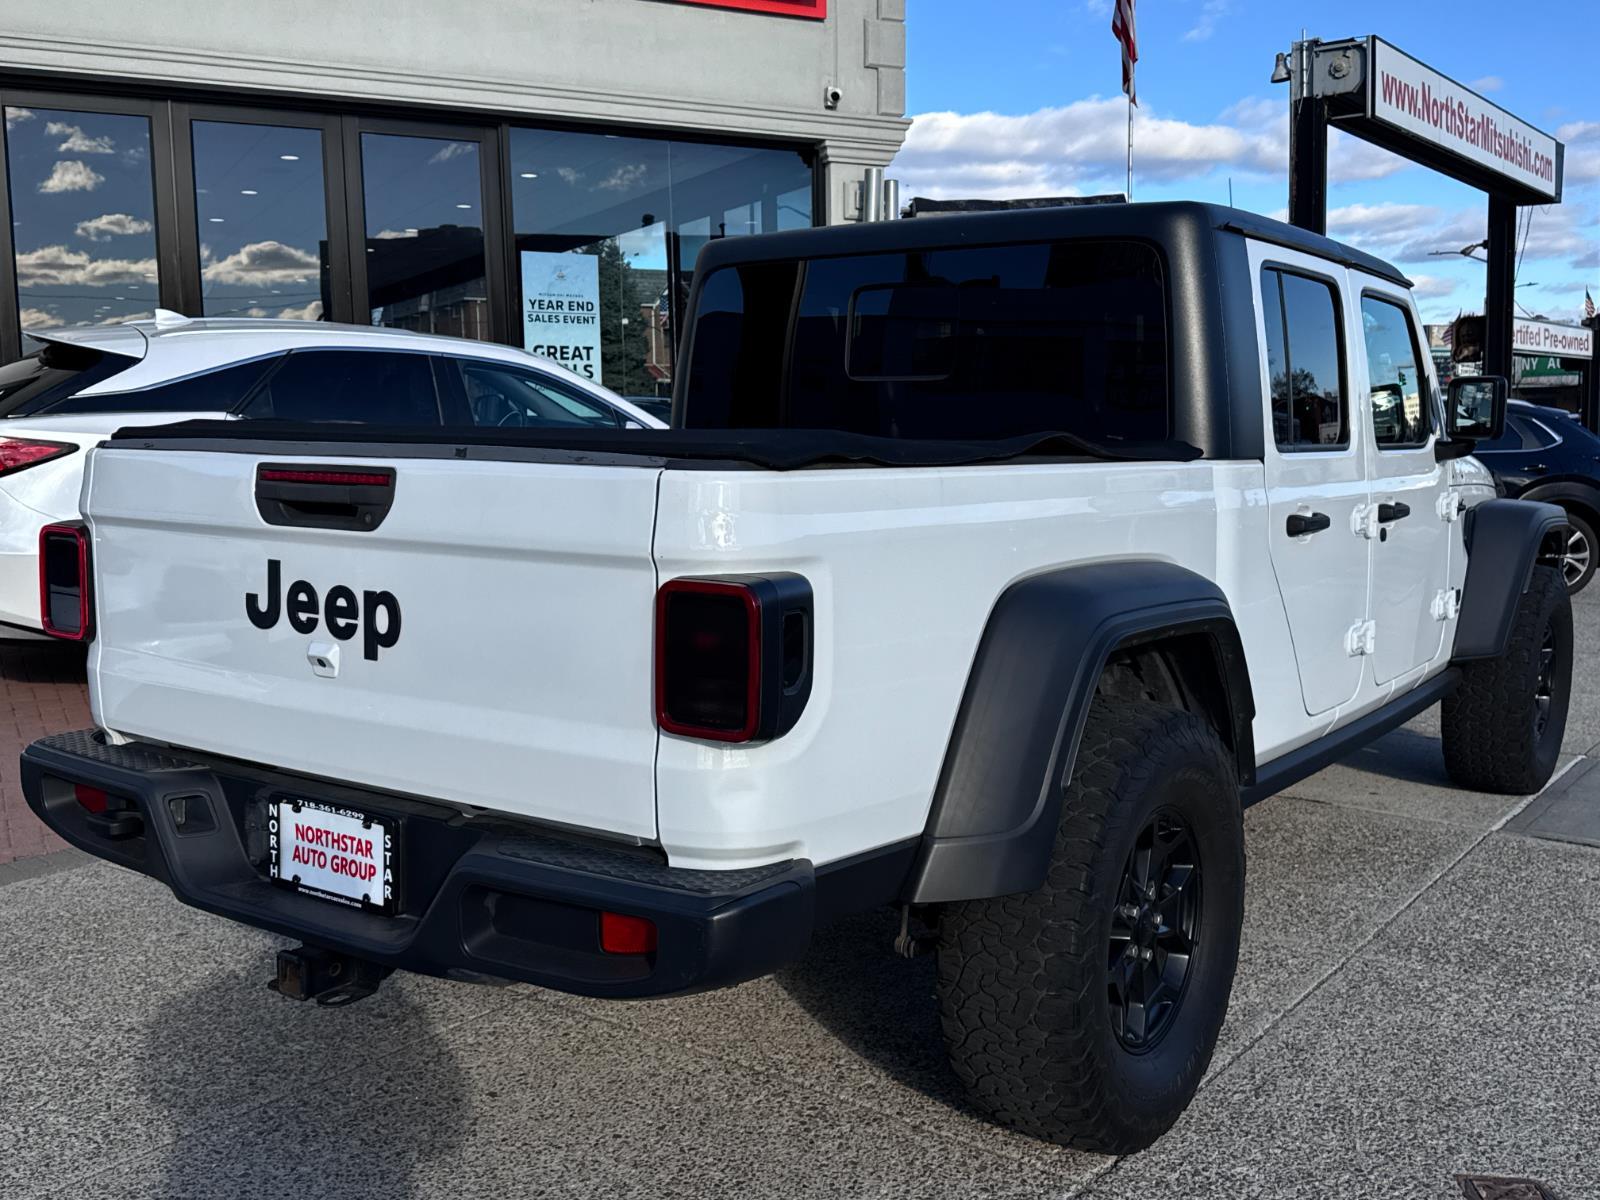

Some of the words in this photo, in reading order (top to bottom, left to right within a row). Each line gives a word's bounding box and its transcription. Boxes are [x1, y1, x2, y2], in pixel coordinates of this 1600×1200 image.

[1381, 70, 1553, 183] www.NorthStarMitsubishi.com
[527, 313, 560, 323] SALES
[563, 315, 596, 325] EVENT
[528, 298, 564, 311] YEAR
[568, 300, 594, 312] END
[533, 345, 594, 361] GREAT
[1512, 324, 1541, 346] ertifed
[1543, 328, 1590, 352] Pre-owned
[1521, 357, 1538, 370] NY
[245, 558, 402, 662] Jeep
[297, 799, 365, 820] 718-361-6299
[268, 803, 278, 879] NORTH
[294, 823, 374, 860] NORTHSTAR
[292, 844, 327, 869] AUTO
[330, 854, 377, 882] GROUP
[384, 834, 393, 900] STAR
